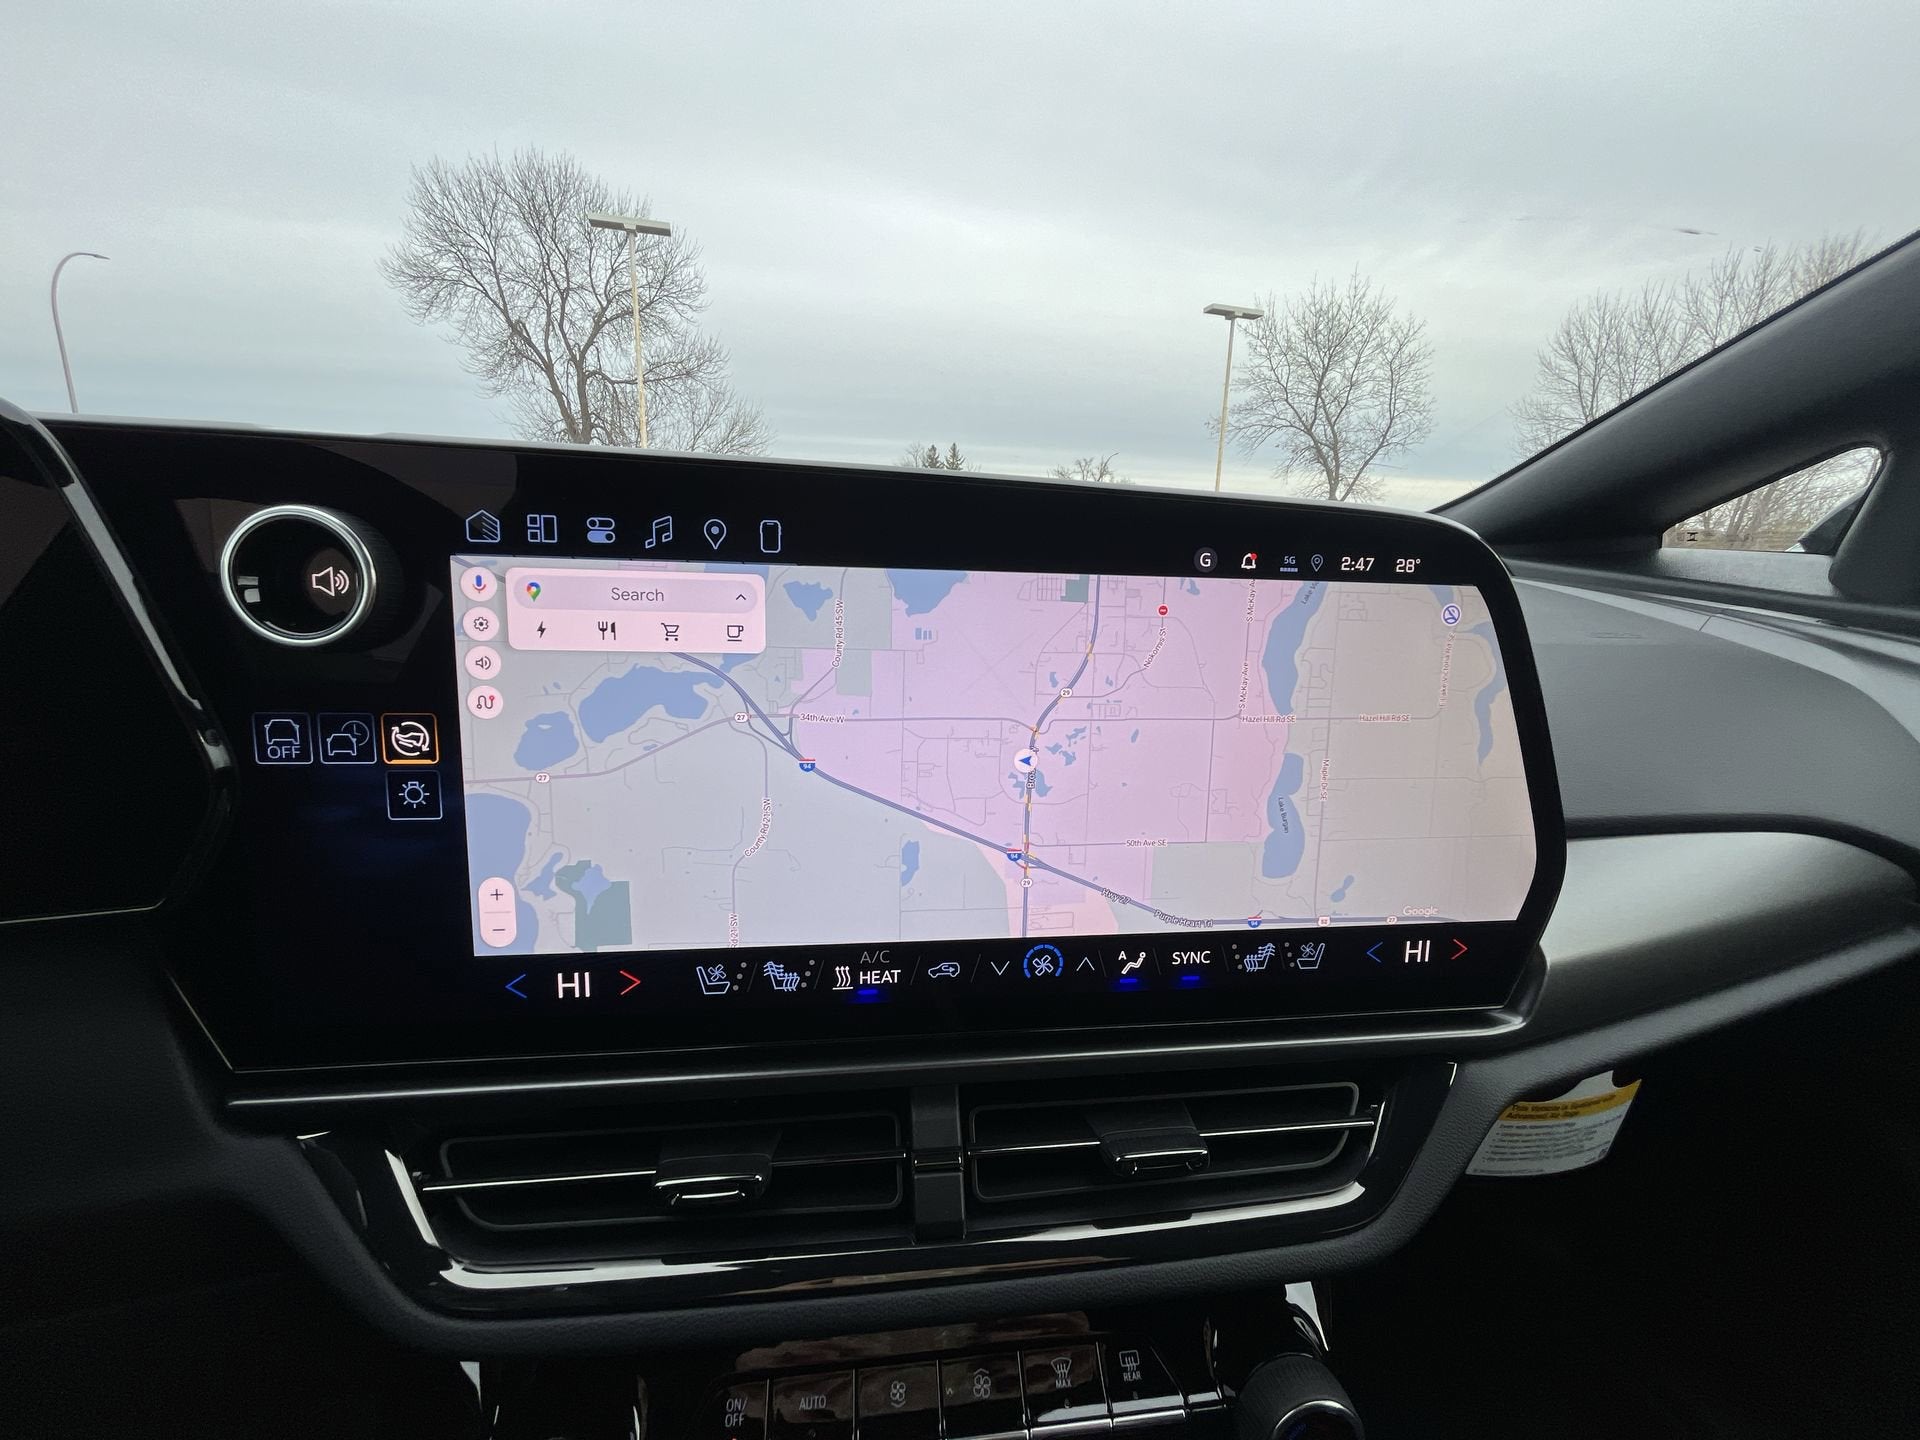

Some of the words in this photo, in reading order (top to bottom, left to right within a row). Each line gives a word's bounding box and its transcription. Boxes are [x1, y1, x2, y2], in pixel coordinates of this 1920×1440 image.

[1200, 552, 1211, 567] G
[1283, 555, 1296, 565] 5G
[1341, 556, 1375, 571] 2:47
[1396, 558, 1421, 573] 28°
[611, 586, 665, 602] Search
[835, 600, 843, 614] SW
[1247, 588, 1256, 616] McKay
[835, 615, 843, 626] 45
[835, 627, 843, 638] Rd
[832, 640, 845, 667] County
[1144, 637, 1165, 668] Nokomis
[1159, 627, 1167, 637] St
[1240, 676, 1249, 703] McKay
[800, 713, 818, 722] 34th
[819, 715, 835, 723] Ave
[1242, 715, 1263, 723] Hazel
[1264, 715, 1275, 723] Hill
[1276, 715, 1286, 723] Rd
[267, 745, 301, 759] OFF
[1321, 759, 1330, 780] Maple
[538, 774, 547, 782] 27
[1320, 791, 1328, 801] SE
[744, 834, 766, 857] County
[763, 798, 771, 811] SW
[1126, 839, 1142, 847] 50th
[1142, 839, 1156, 847] Ave
[1157, 839, 1167, 847] SE
[1102, 888, 1120, 902] Hwy
[1154, 909, 1181, 924] Purple
[1180, 917, 1201, 928] Heart
[1402, 906, 1439, 917] Google
[730, 913, 738, 926] SW
[860, 950, 890, 964] A/C
[1118, 951, 1127, 960] A
[1171, 950, 1211, 966] SYNC
[1404, 940, 1431, 963] HI
[860, 969, 901, 985] HEAT
[557, 971, 591, 999] HI
[1056, 1379, 1072, 1389] MAX
[1123, 1371, 1141, 1382] REAR
[726, 1396, 748, 1412] ON/
[799, 1395, 827, 1411] AUTO
[724, 1413, 745, 1428] OFF
